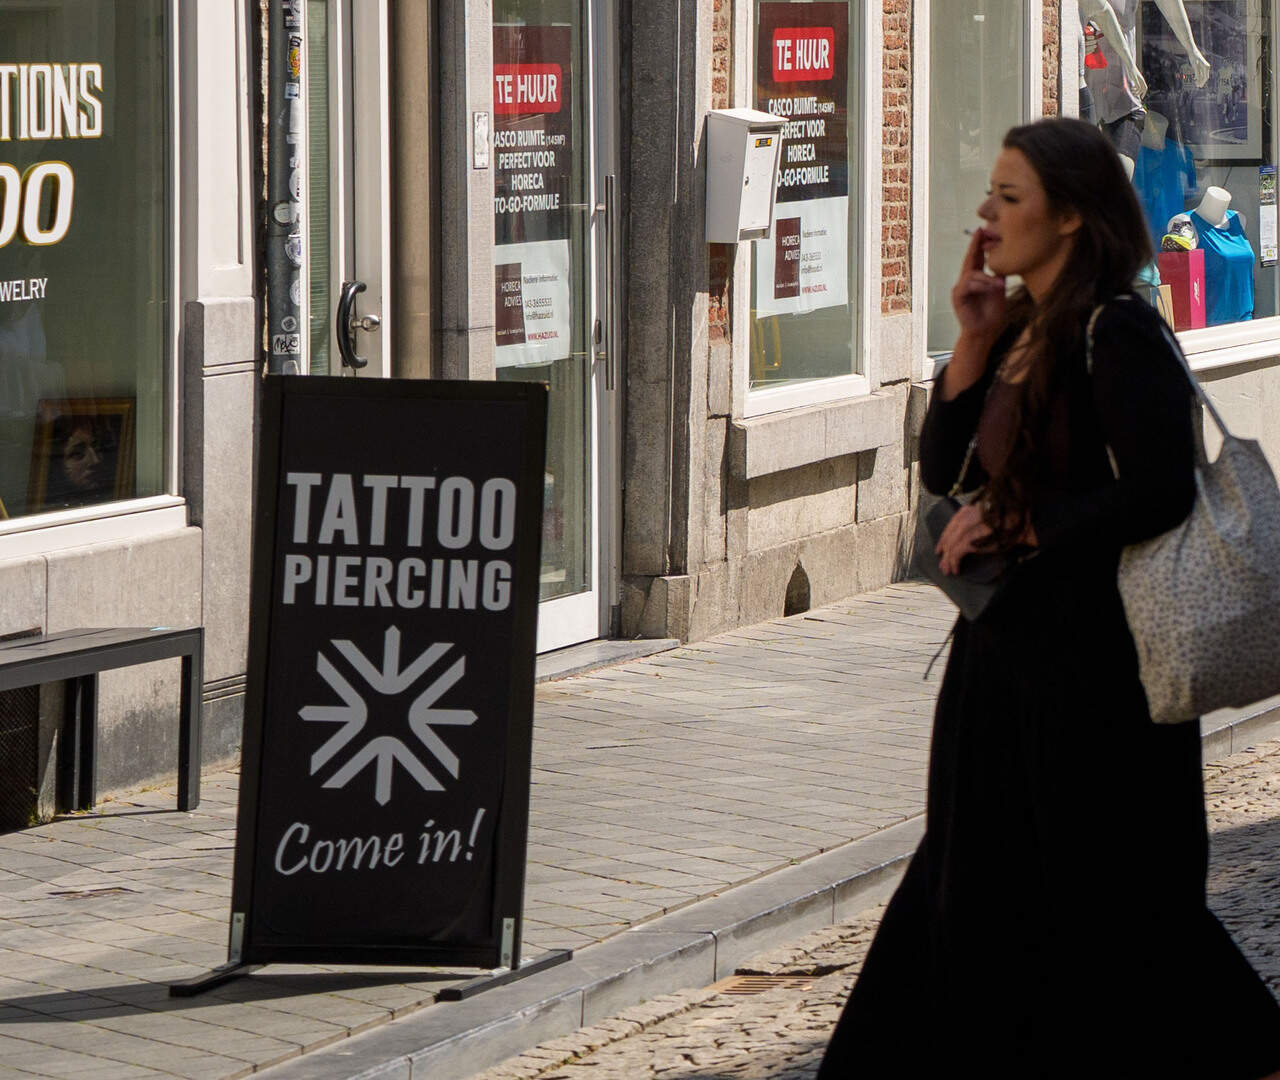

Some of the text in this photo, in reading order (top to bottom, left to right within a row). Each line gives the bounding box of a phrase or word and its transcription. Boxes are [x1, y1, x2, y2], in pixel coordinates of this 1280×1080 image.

[776, 37, 830, 71] TE HUUR
[496, 73, 558, 104] TE HUUR
[0, 62, 103, 140] TIONS
[768, 98, 792, 116] CASCO
[793, 96, 817, 115] RUIMTE
[494, 130, 516, 148] ASCO
[517, 129, 545, 146] RUIMTE
[780, 119, 826, 140] ERFECT VOOR
[498, 150, 556, 170] PERFECT VOOR
[787, 143, 816, 162] HORECA
[511, 172, 545, 191] HORECA
[776, 165, 829, 187] O-GO-FORMULE
[495, 193, 560, 214] TO-GO-FORMULE
[0, 277, 48, 303] WELRY
[286, 472, 518, 551] TATTOO
[282, 554, 513, 611] PIERCING
[274, 807, 486, 876] Come in!
